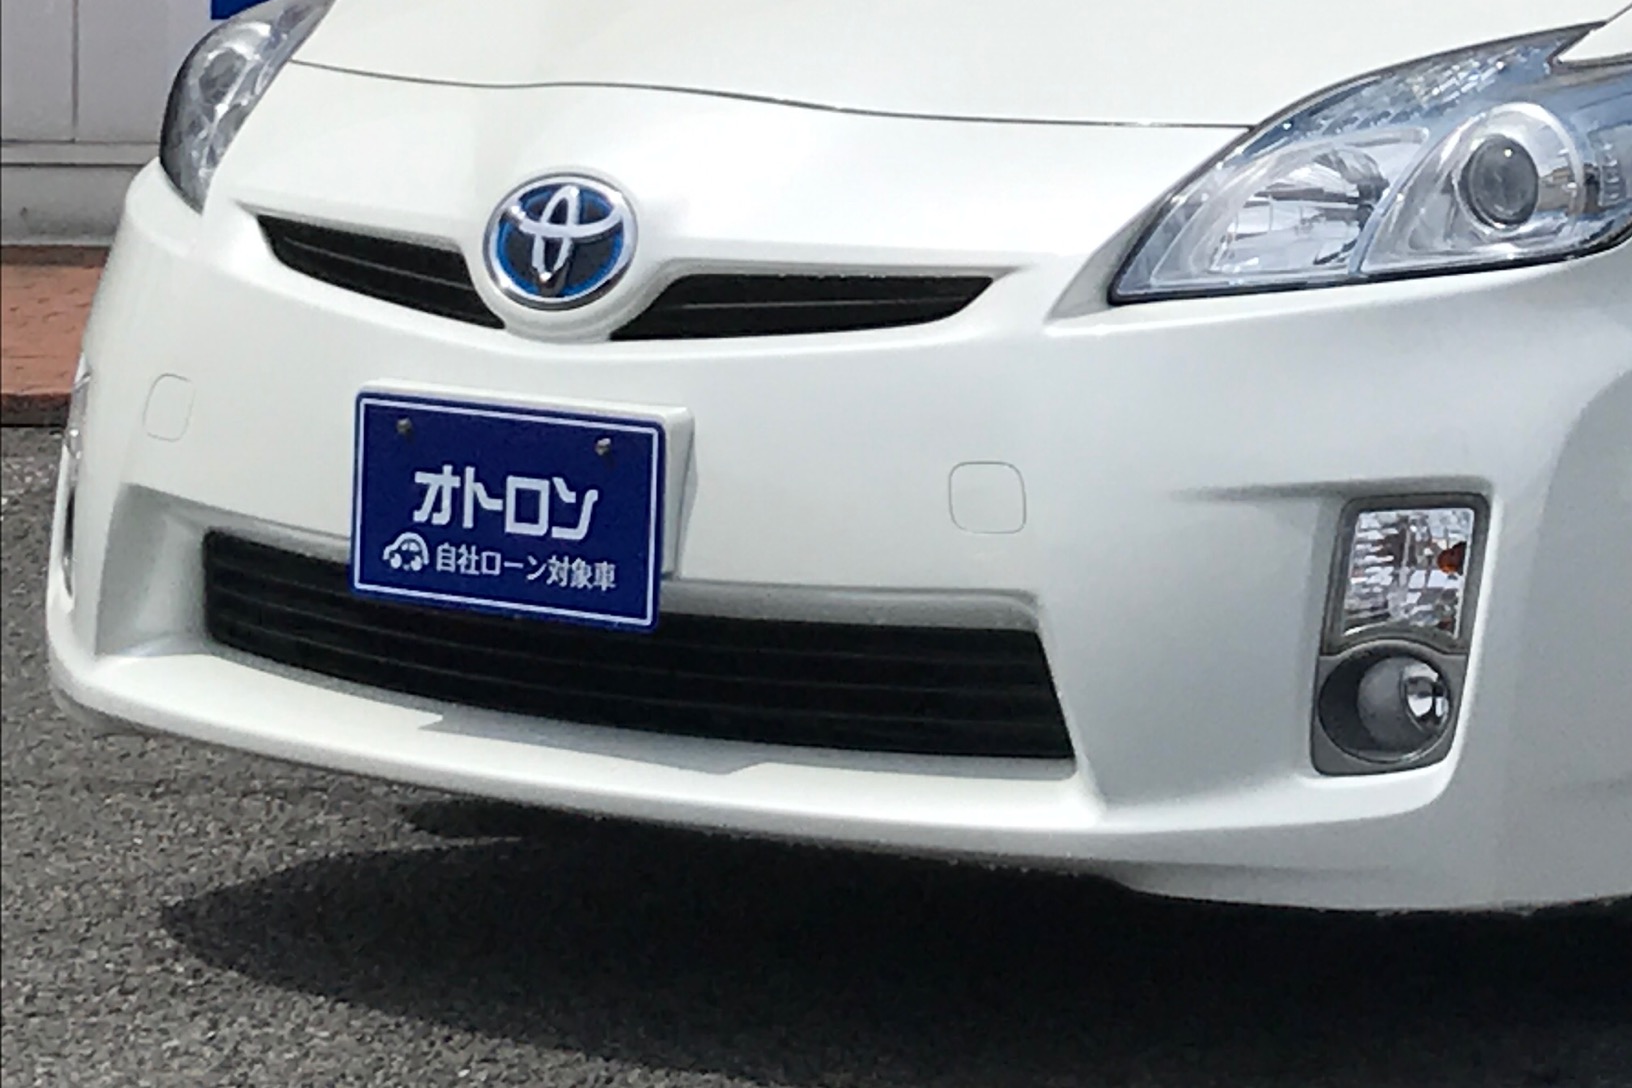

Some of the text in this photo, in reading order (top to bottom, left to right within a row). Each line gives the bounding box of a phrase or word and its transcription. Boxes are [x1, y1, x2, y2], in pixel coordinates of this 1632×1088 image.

[413, 464, 598, 540] オトロン
[436, 542, 616, 591] 自社ローン対象車
